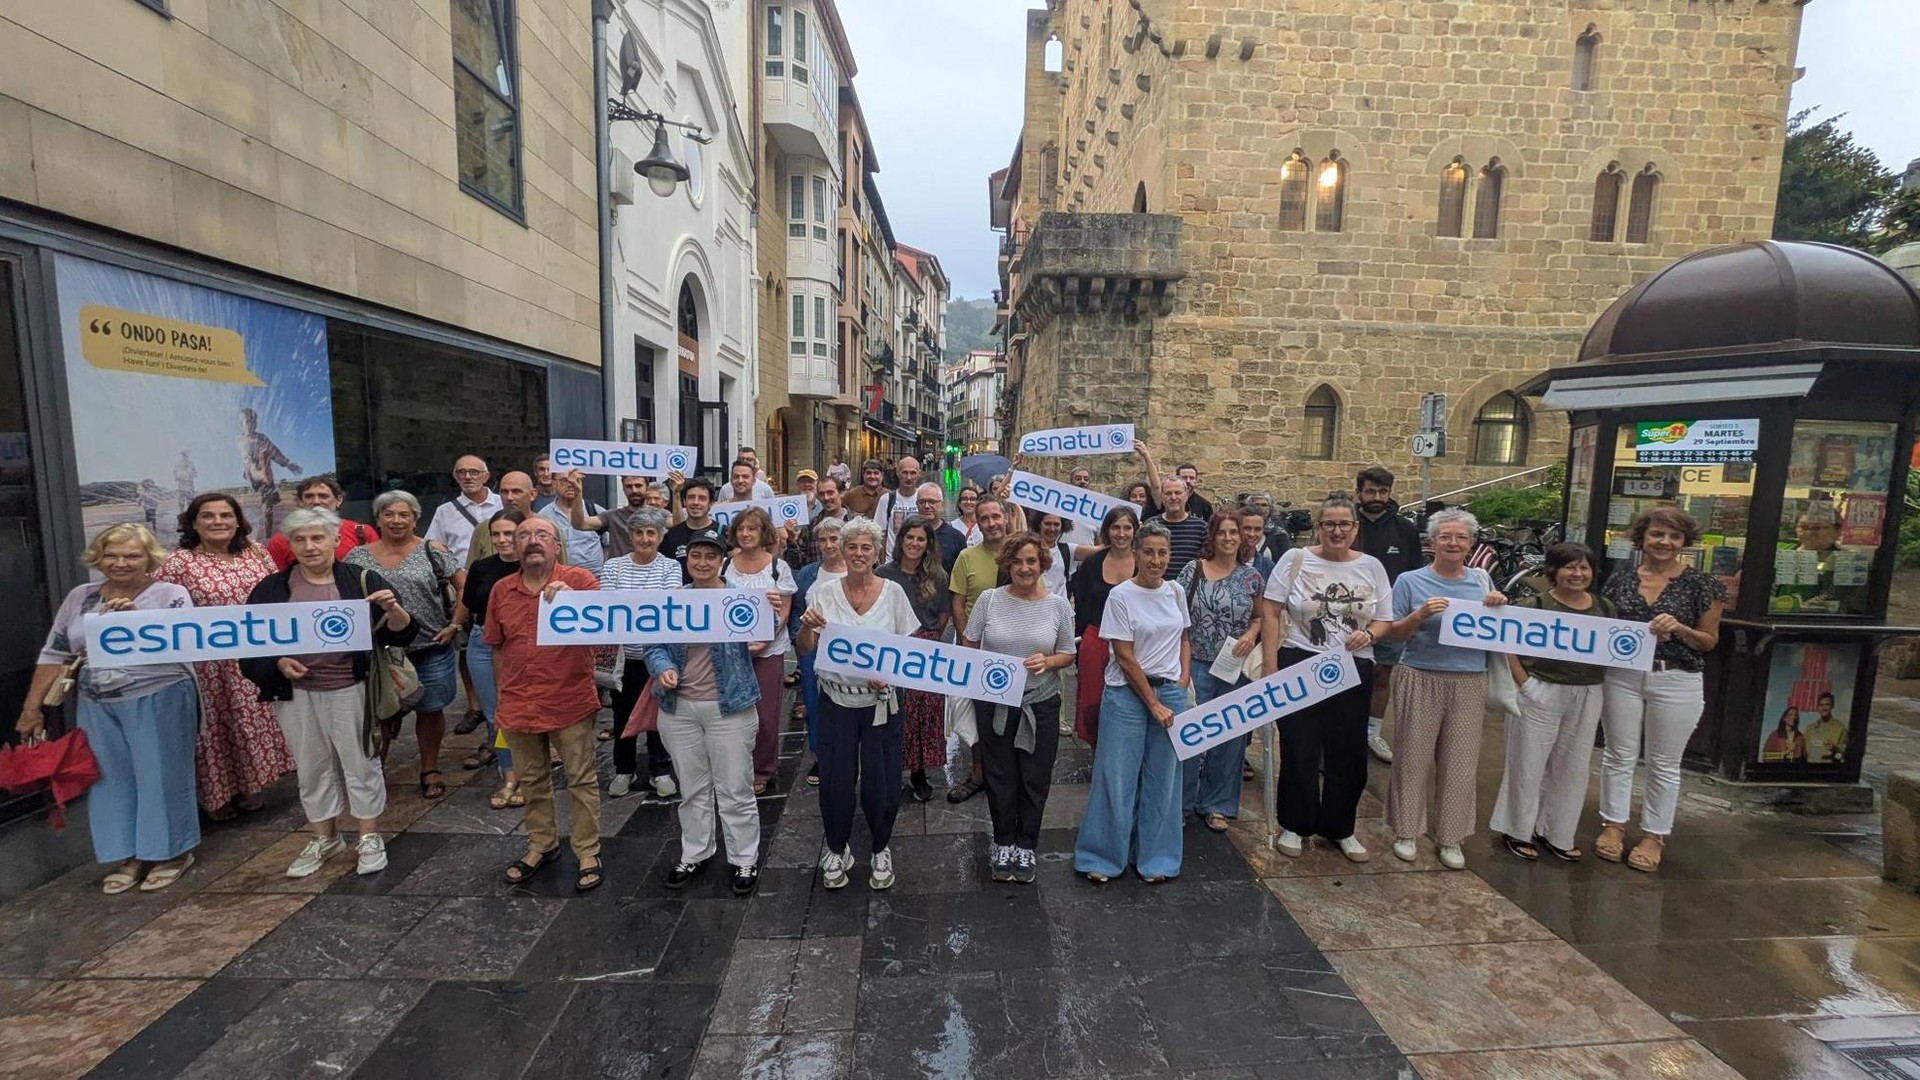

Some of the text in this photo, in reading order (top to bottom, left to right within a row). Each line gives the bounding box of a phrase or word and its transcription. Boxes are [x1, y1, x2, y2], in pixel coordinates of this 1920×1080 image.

[120, 321, 212, 352] ONDO PASA!
[554, 446, 658, 470] esnatu
[1023, 430, 1102, 453] esnatu
[1705, 437, 1755, 446] Septiembre
[1013, 480, 1108, 521] esnatu
[99, 610, 299, 655] esnatu
[549, 595, 710, 633] esnatu
[1452, 612, 1596, 654] esnatu
[827, 637, 972, 687] esnatu
[1179, 675, 1308, 747] esnatu
